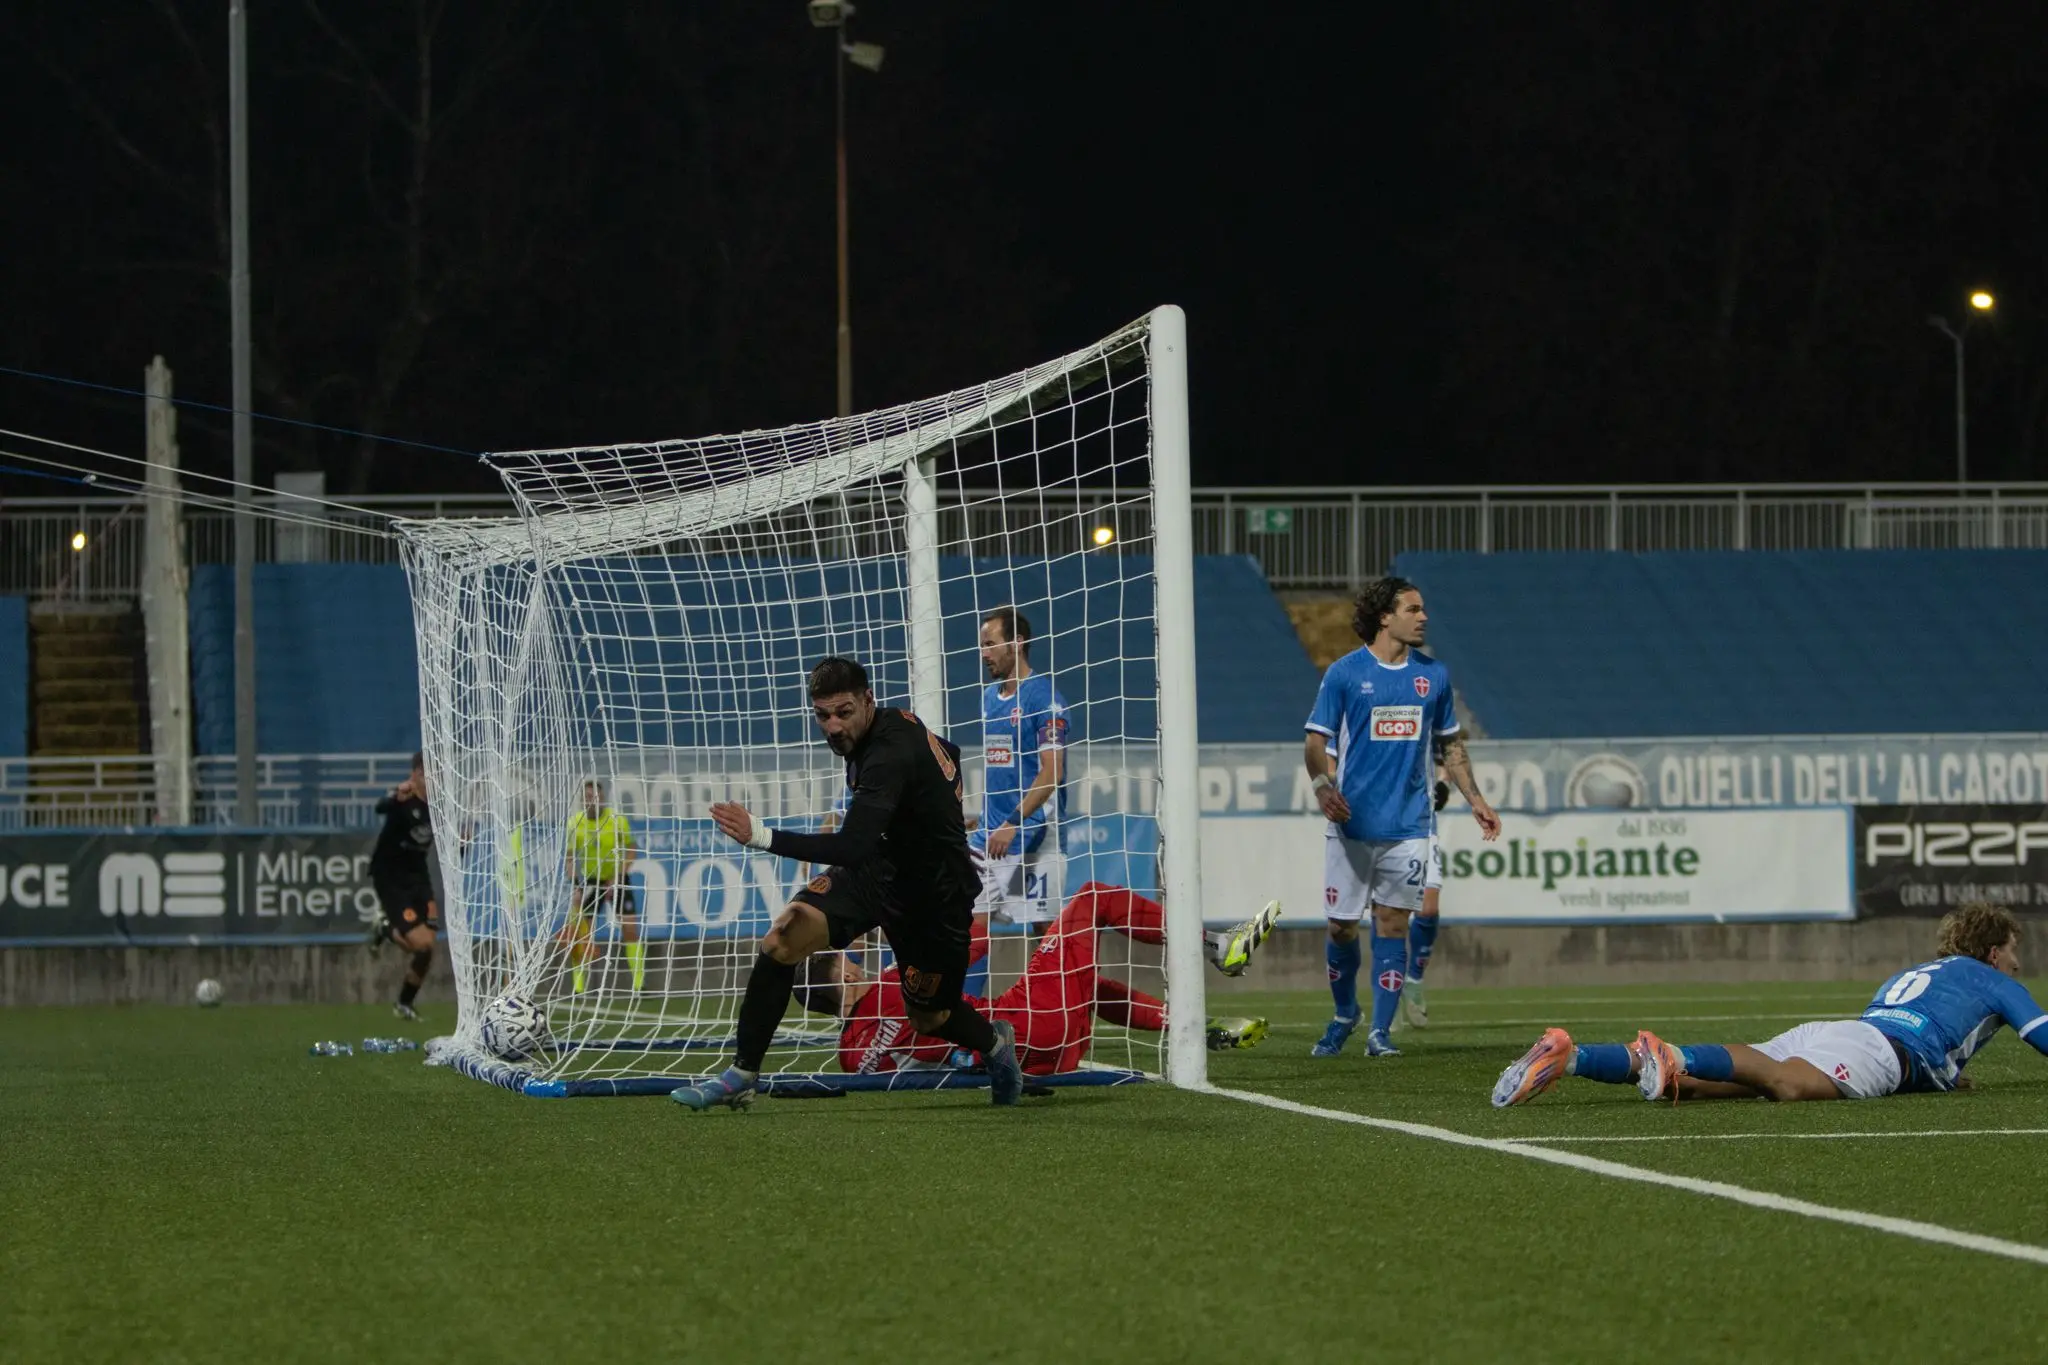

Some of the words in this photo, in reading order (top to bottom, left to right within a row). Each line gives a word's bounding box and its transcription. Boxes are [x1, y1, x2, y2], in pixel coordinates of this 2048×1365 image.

[1378, 721, 1415, 735] IGOR
[1658, 755, 1782, 806] QUELLI
[256, 850, 373, 884] Miner
[1440, 836, 1700, 890] solipiante
[0, 863, 70, 909] CE
[255, 884, 382, 922] Energ
[1025, 872, 1048, 899] 21
[1884, 964, 1943, 1005] 6
